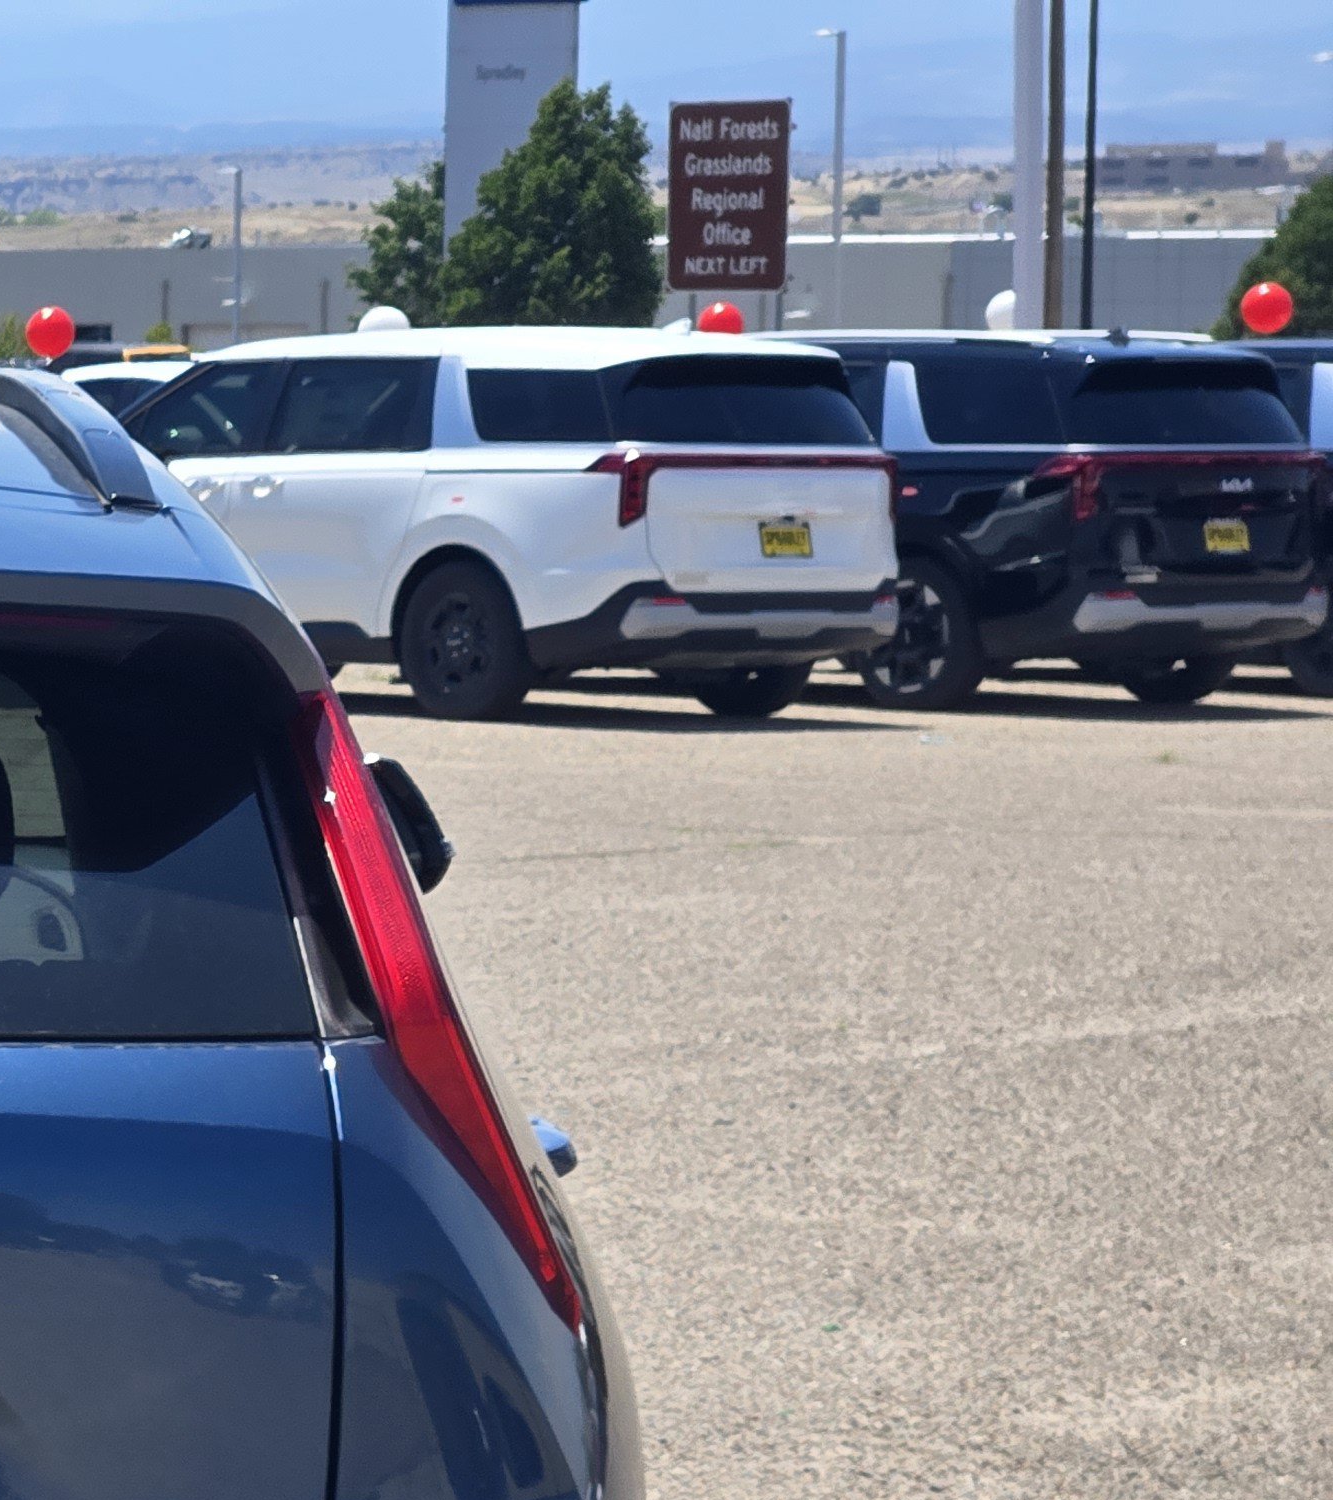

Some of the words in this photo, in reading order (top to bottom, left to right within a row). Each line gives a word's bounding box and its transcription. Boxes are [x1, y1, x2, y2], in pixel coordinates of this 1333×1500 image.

[719, 116, 780, 140] Forests
[684, 152, 772, 177] Grasslands
[691, 187, 764, 217] Regional
[703, 222, 752, 246] Office
[684, 256, 726, 275] NEXT
[729, 256, 768, 275] LEFT
